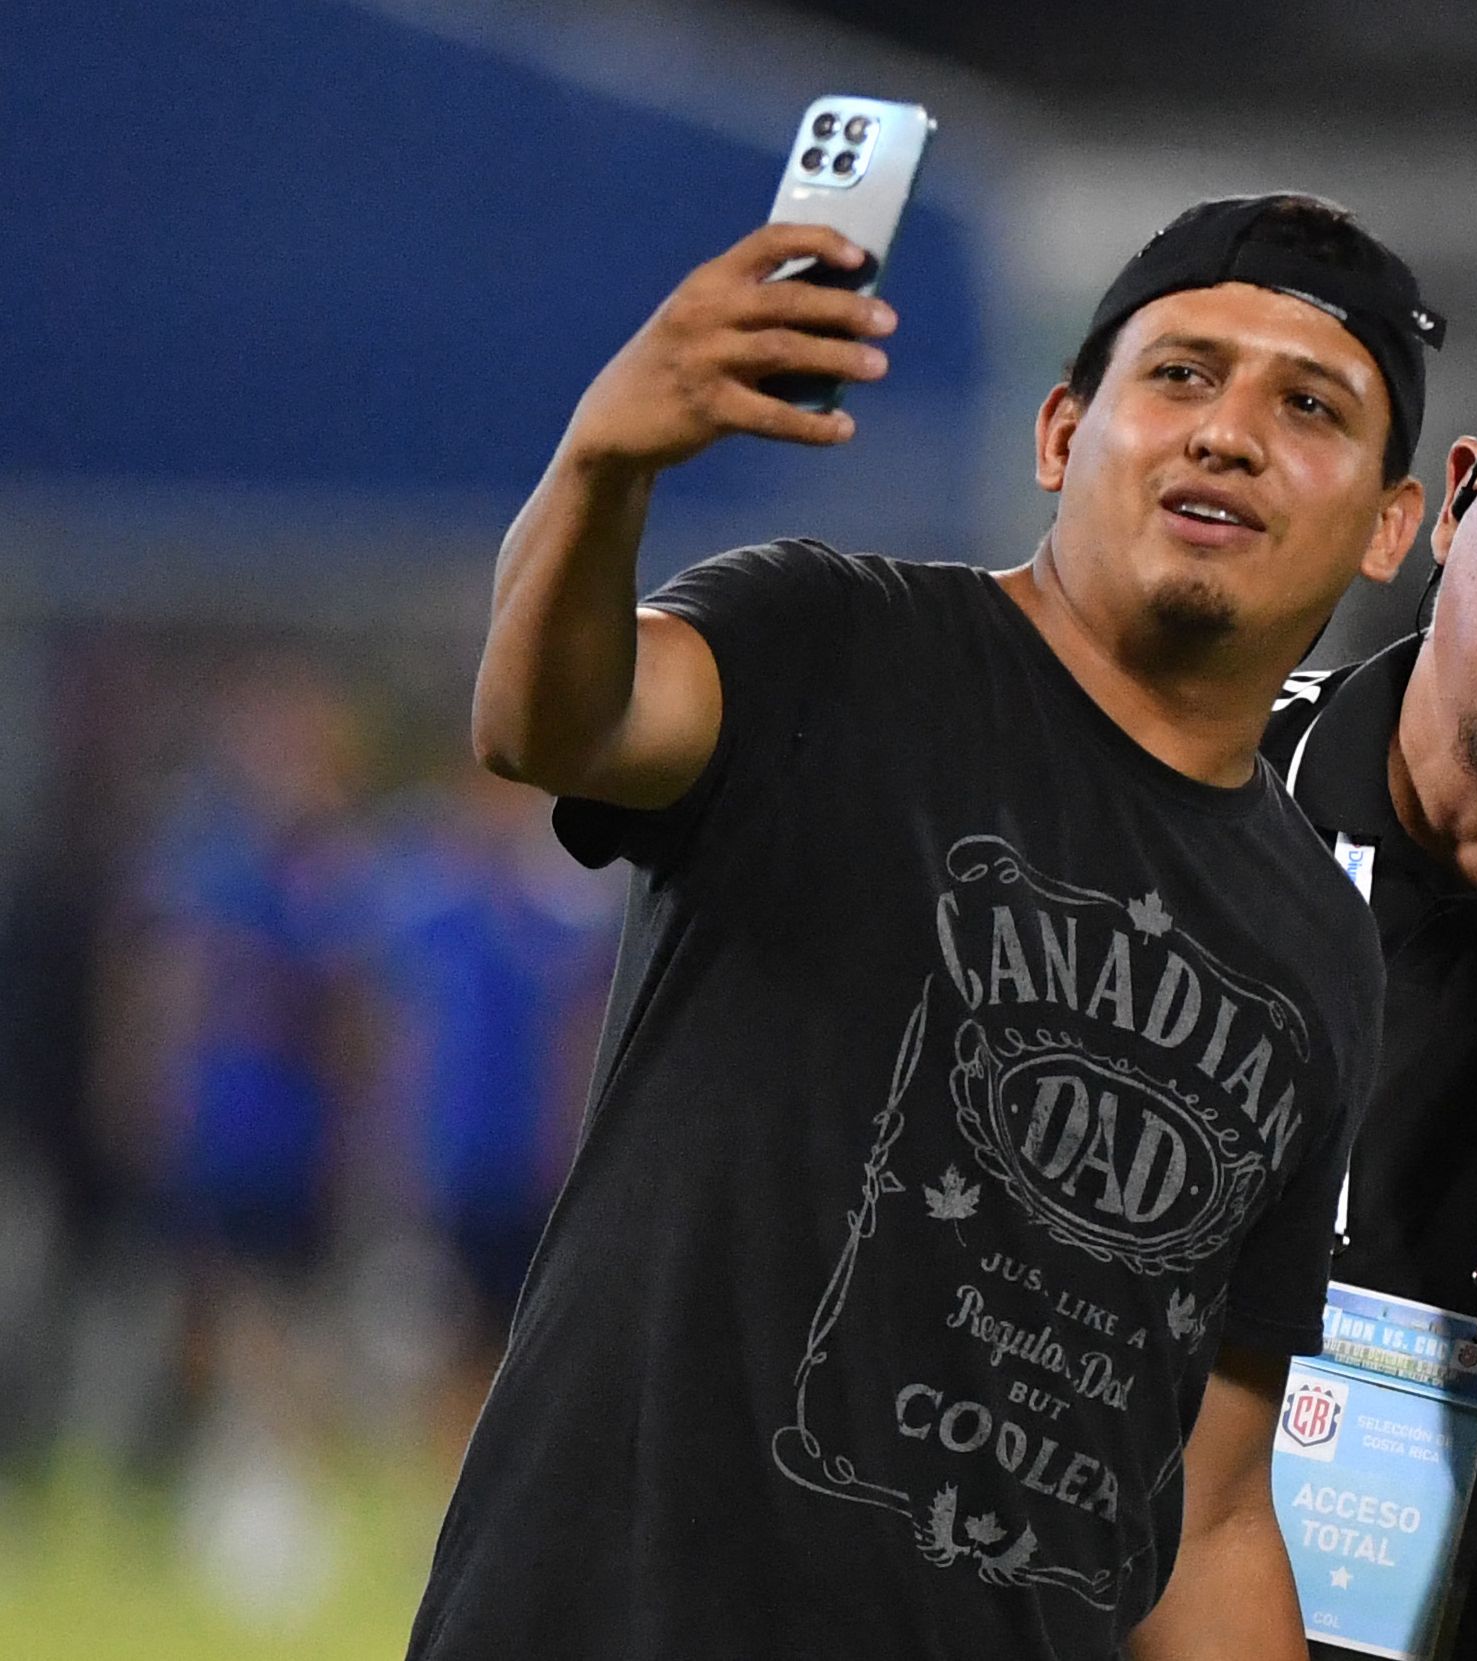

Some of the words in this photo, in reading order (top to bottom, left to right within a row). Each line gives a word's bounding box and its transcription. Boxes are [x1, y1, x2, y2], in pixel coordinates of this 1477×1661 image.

[936, 890, 1301, 1171] CANADIAN
[1020, 1075, 1188, 1224] DAD
[1055, 1291, 1119, 1336] LIKE
[1126, 1327, 1147, 1349] A
[1008, 1380, 1071, 1420] BUT
[1293, 1395, 1330, 1438] CR
[1357, 1415, 1432, 1442] SELECCIÓN
[1362, 1434, 1405, 1454] COSTA
[1408, 1445, 1440, 1463] RICA
[1292, 1482, 1421, 1534] ACCESO
[1302, 1519, 1395, 1568] TOTAL
